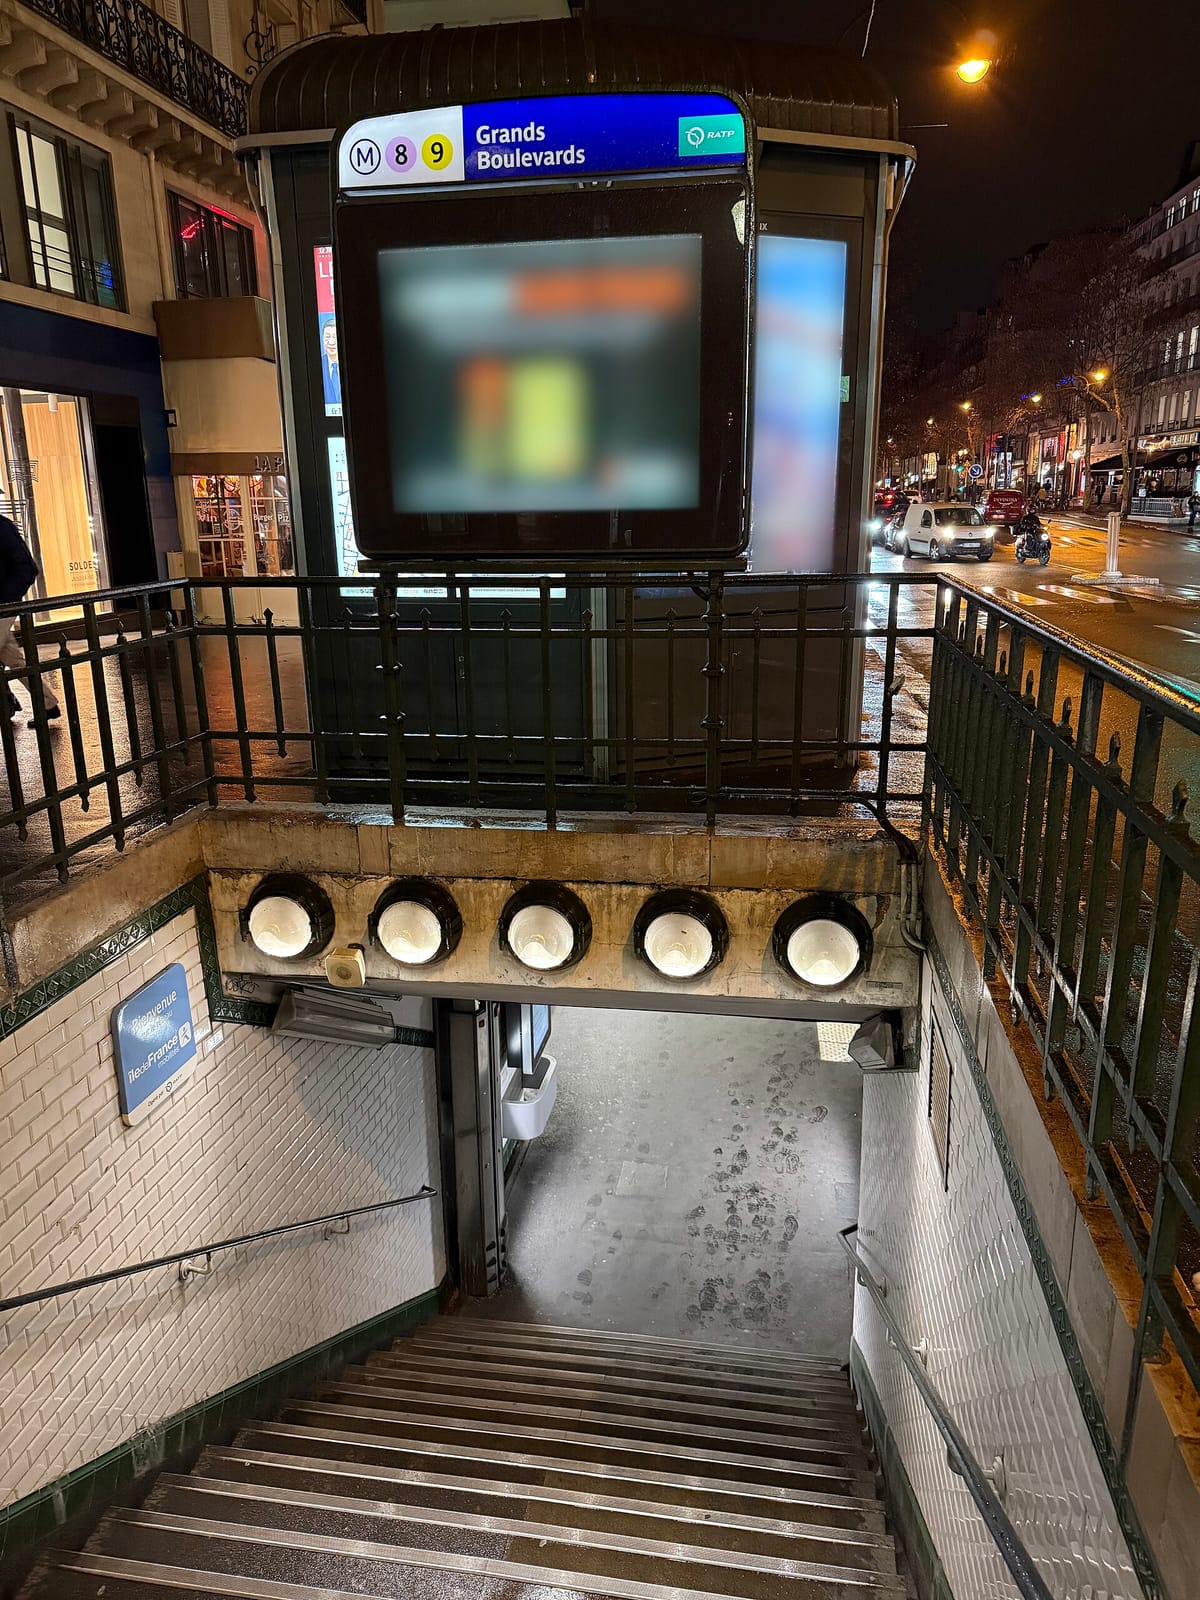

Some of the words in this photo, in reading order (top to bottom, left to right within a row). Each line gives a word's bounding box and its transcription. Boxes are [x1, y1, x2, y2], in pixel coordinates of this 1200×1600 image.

[475, 121, 546, 144] Grands
[707, 130, 735, 139] RATP
[395, 143, 408, 165] 8
[430, 141, 444, 163] 9
[477, 144, 586, 170] Boulevards
[132, 990, 177, 1032] Bienvenue
